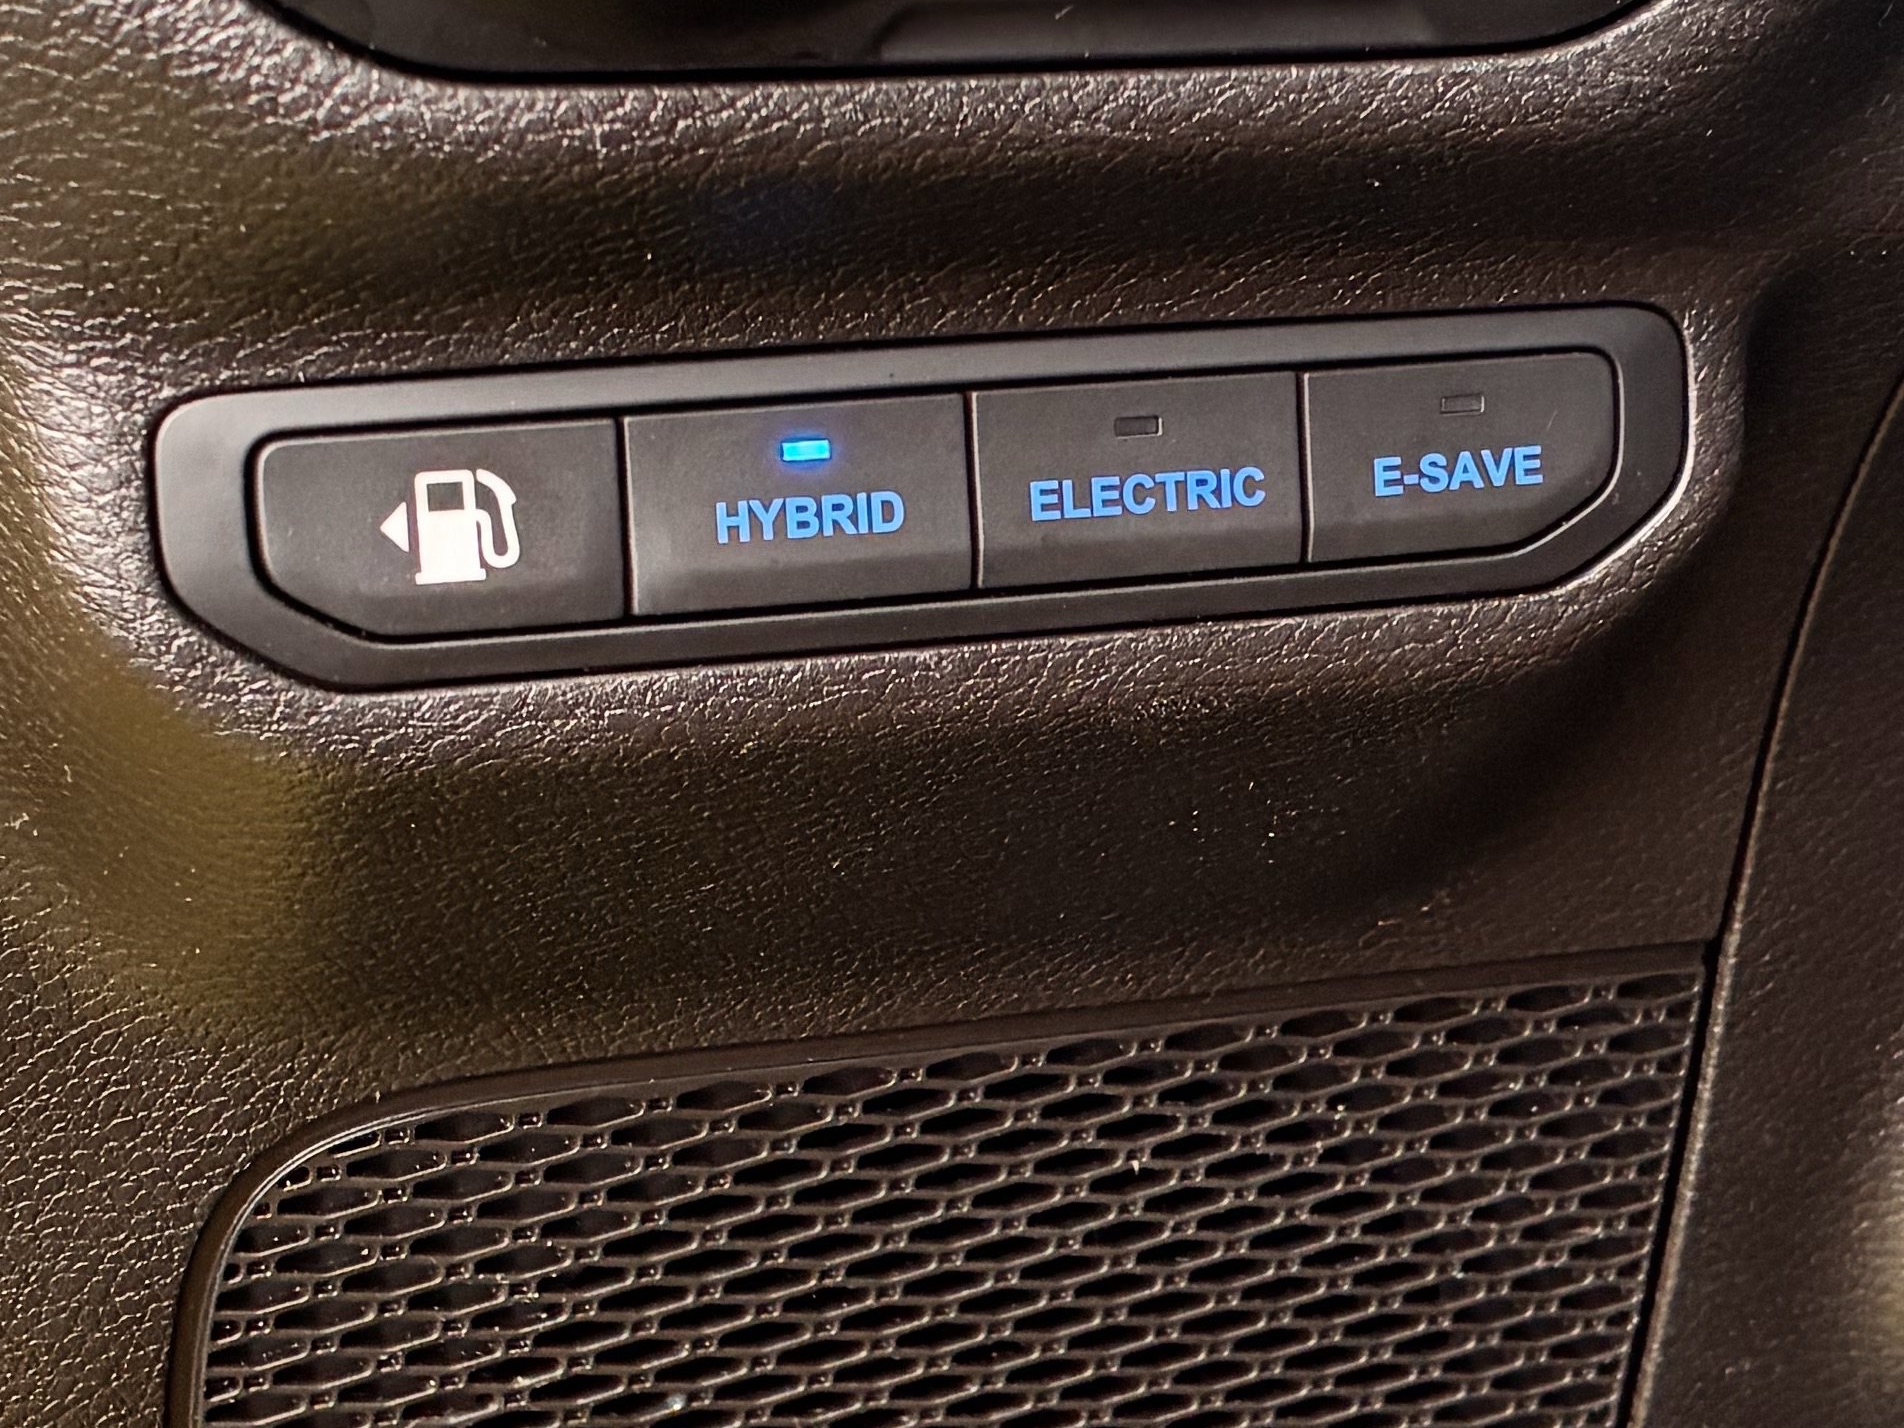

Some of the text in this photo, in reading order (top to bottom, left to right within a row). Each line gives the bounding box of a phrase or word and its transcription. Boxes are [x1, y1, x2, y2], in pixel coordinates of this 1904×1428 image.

[1029, 465, 1265, 521] ELECTRIC
[1372, 444, 1543, 497] E-SAVE
[715, 490, 905, 544] HYBRID
